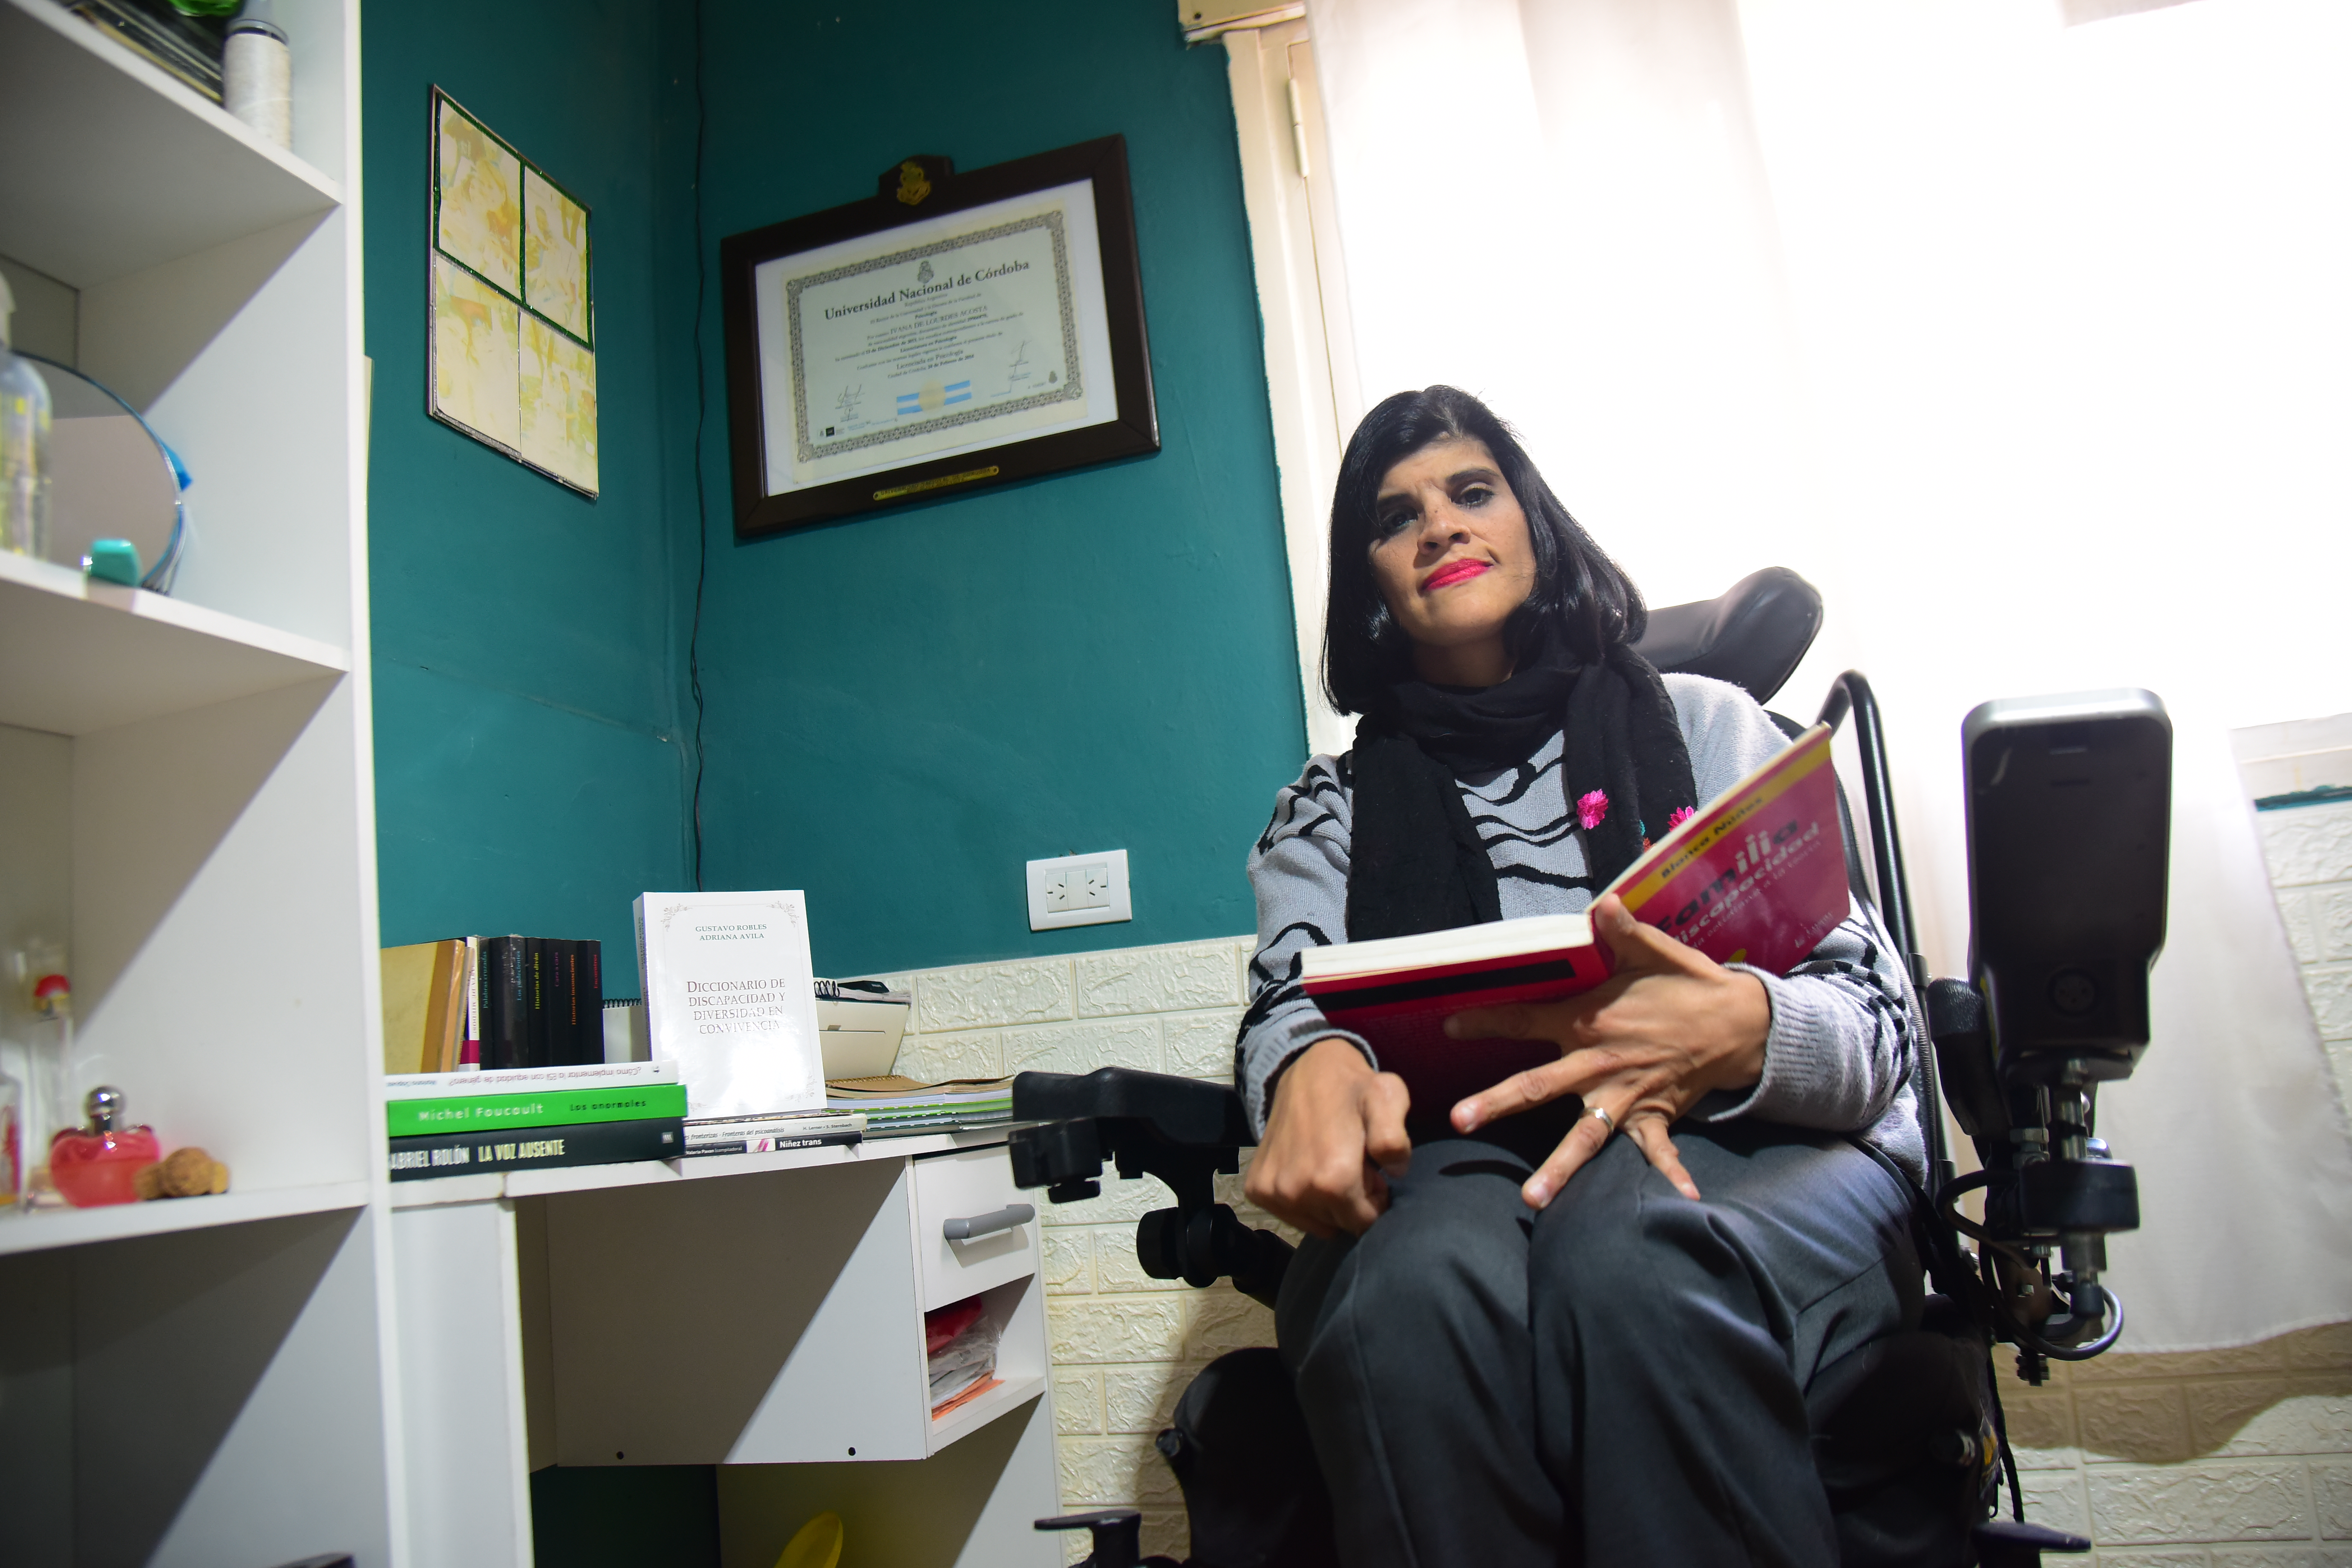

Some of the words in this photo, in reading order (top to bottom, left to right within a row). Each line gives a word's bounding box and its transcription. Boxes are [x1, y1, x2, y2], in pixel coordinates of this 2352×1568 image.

[824, 293, 895, 320] Universidad
[899, 278, 953, 301] Nacional
[957, 274, 971, 286] de
[975, 260, 1030, 282] Córdoba
[891, 325, 912, 334] IVANA
[914, 320, 925, 329] DE
[960, 306, 988, 317] ACOSTA
[1663, 837, 1709, 878] Blanca
[1656, 819, 1798, 932] Familia
[687, 979, 767, 993] DICCIONARIO
[770, 978, 786, 989] DE
[689, 993, 775, 1007] DISCAPACIDAD
[778, 992, 786, 1002] Y
[693, 1007, 765, 1020] DIVERSIDAD
[769, 1006, 783, 1016] EN
[699, 1020, 780, 1034] CONVIVENCIA
[496, 1073, 528, 1083] equidad
[547, 1072, 557, 1081] ESI
[568, 1068, 614, 1078] implementar
[617, 1066, 641, 1076] ¿Cómo
[449, 1075, 481, 1086] género?
[418, 1107, 469, 1121] Michel
[475, 1103, 543, 1118] Foucault
[592, 1100, 646, 1110] anormales
[755, 1127, 785, 1136] psicoanálisis
[779, 1140, 801, 1148] Niñez
[389, 1150, 431, 1170] ABRIEL
[431, 1144, 470, 1167] ROLÓN
[478, 1145, 493, 1162] LA
[494, 1143, 517, 1161] VOZ
[518, 1139, 566, 1159] AUSENTE
